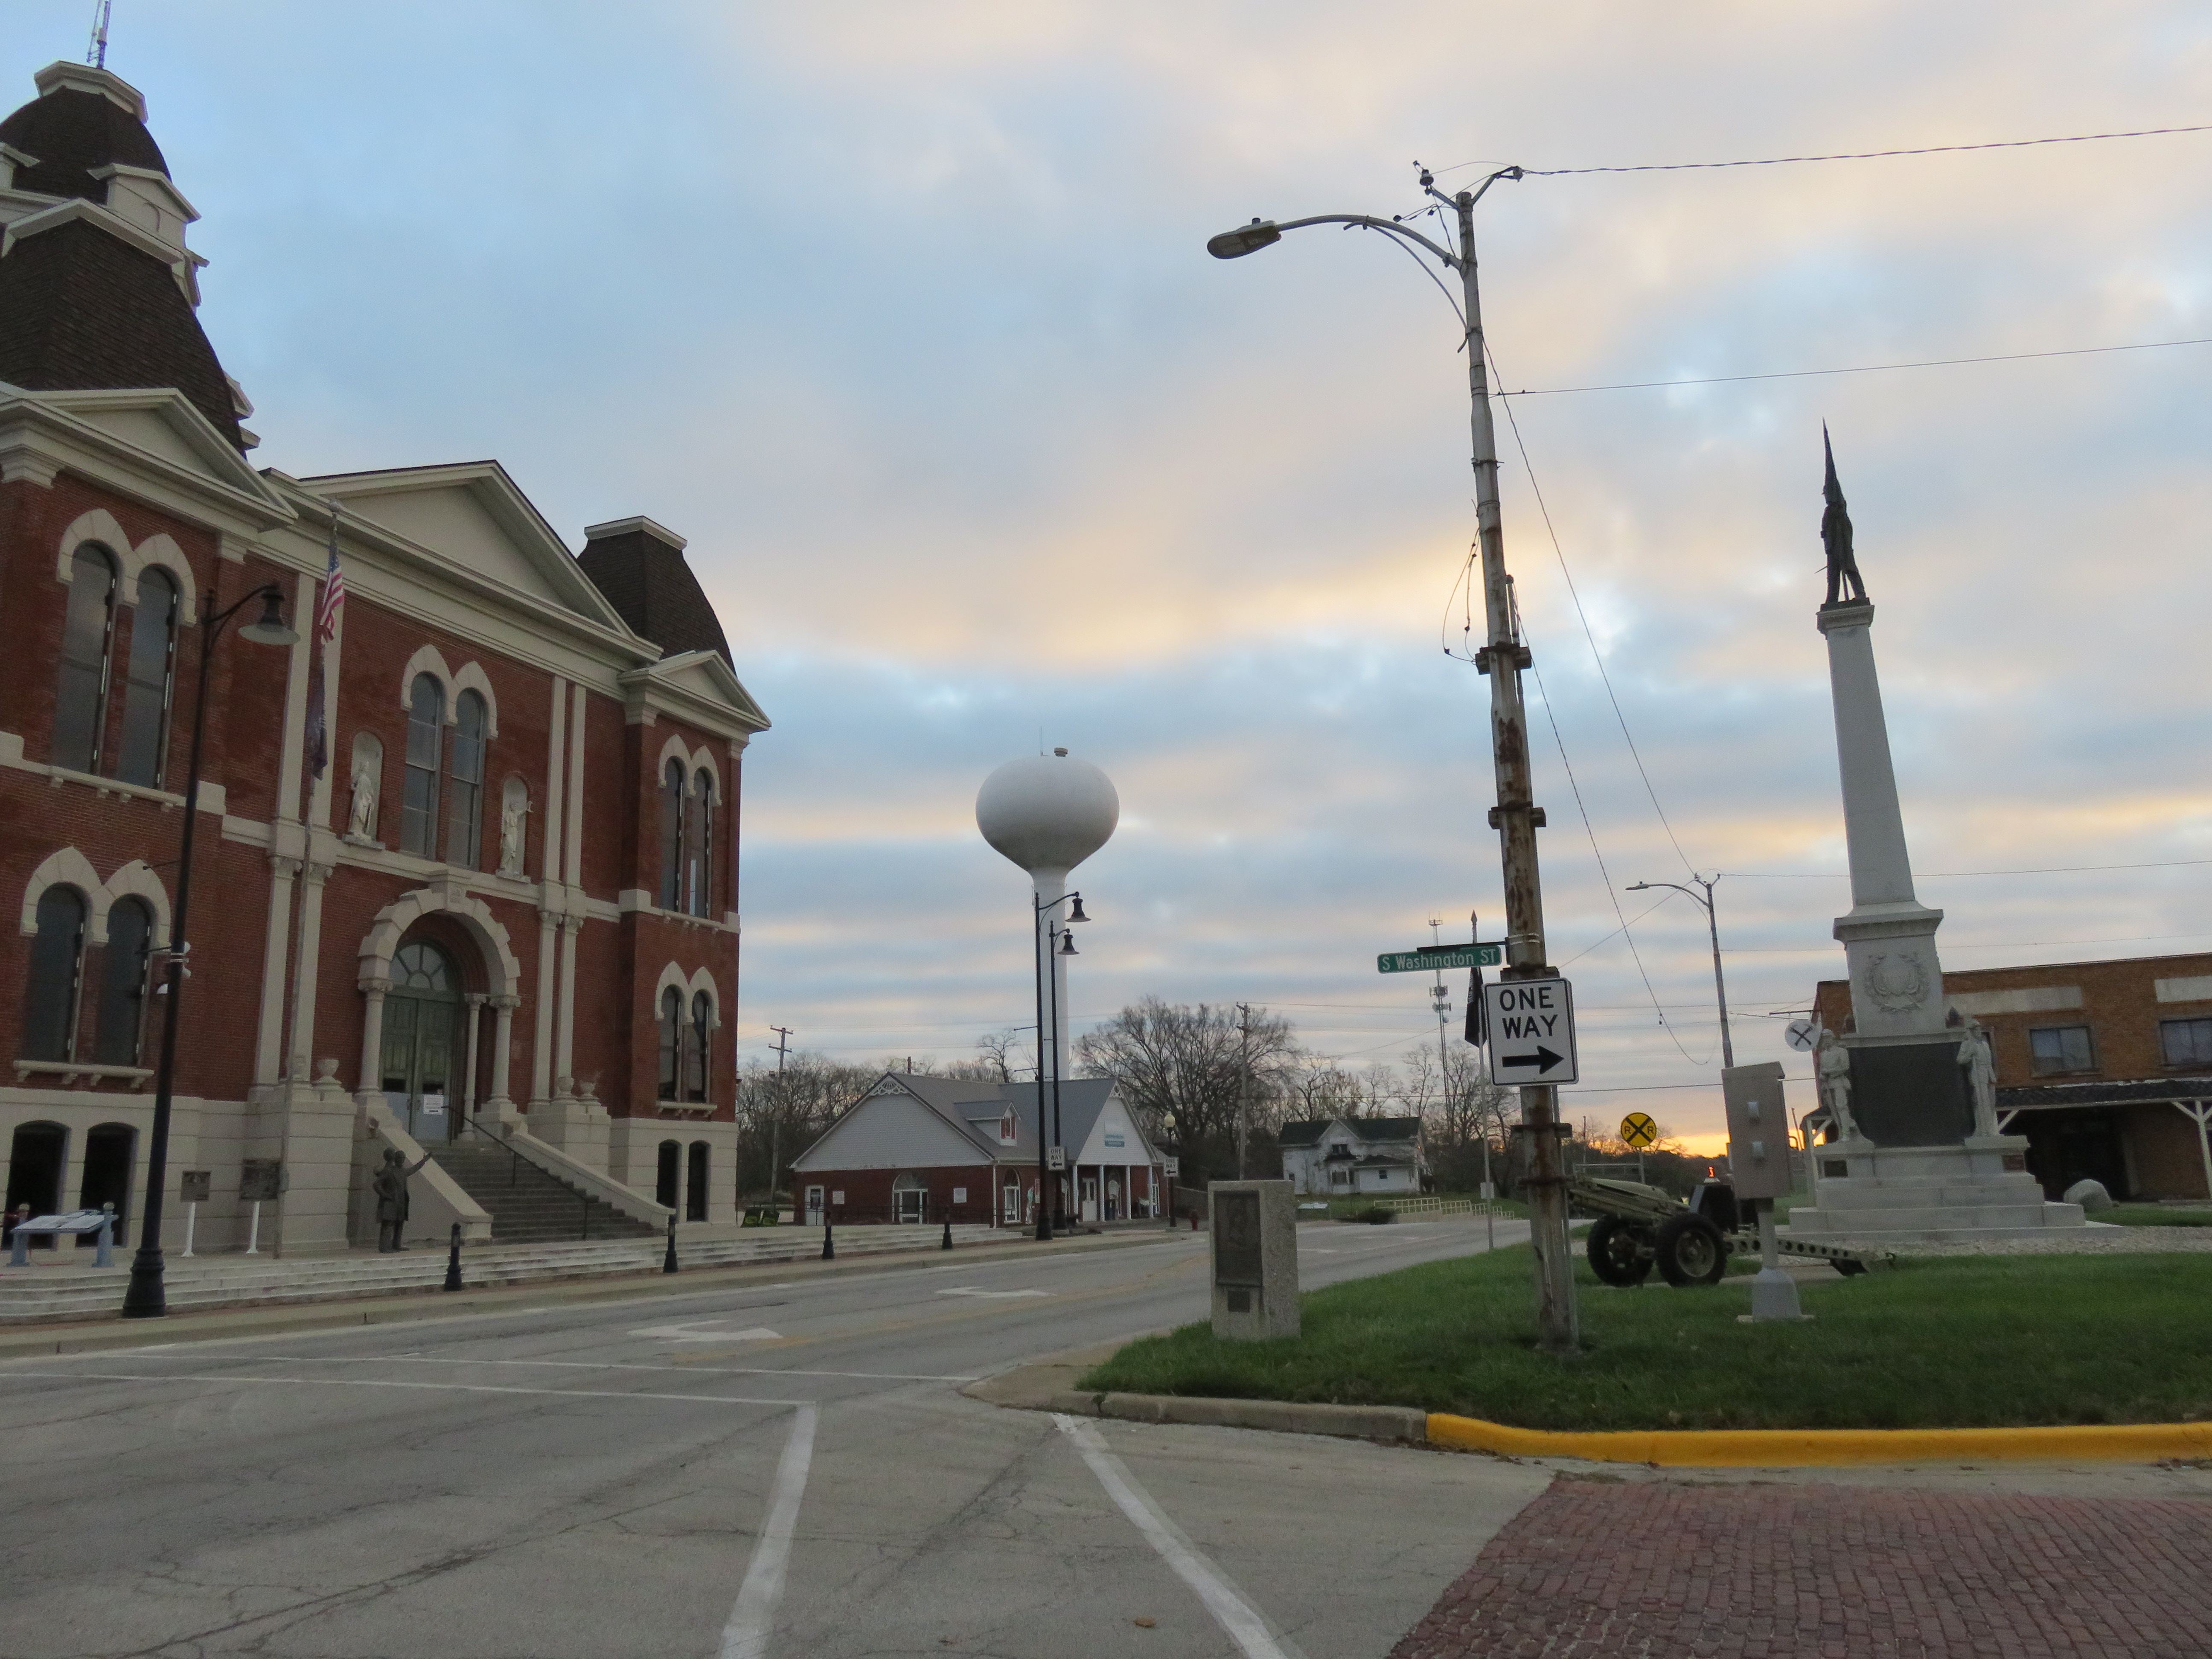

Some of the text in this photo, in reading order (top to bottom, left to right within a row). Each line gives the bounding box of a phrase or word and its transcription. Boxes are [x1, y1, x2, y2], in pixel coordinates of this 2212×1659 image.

[1382, 949, 1496, 970] S Washington ST
[1499, 987, 1554, 1011] ONE
[1502, 1014, 1558, 1039] WAY
[1624, 1126, 1654, 1134] R R
